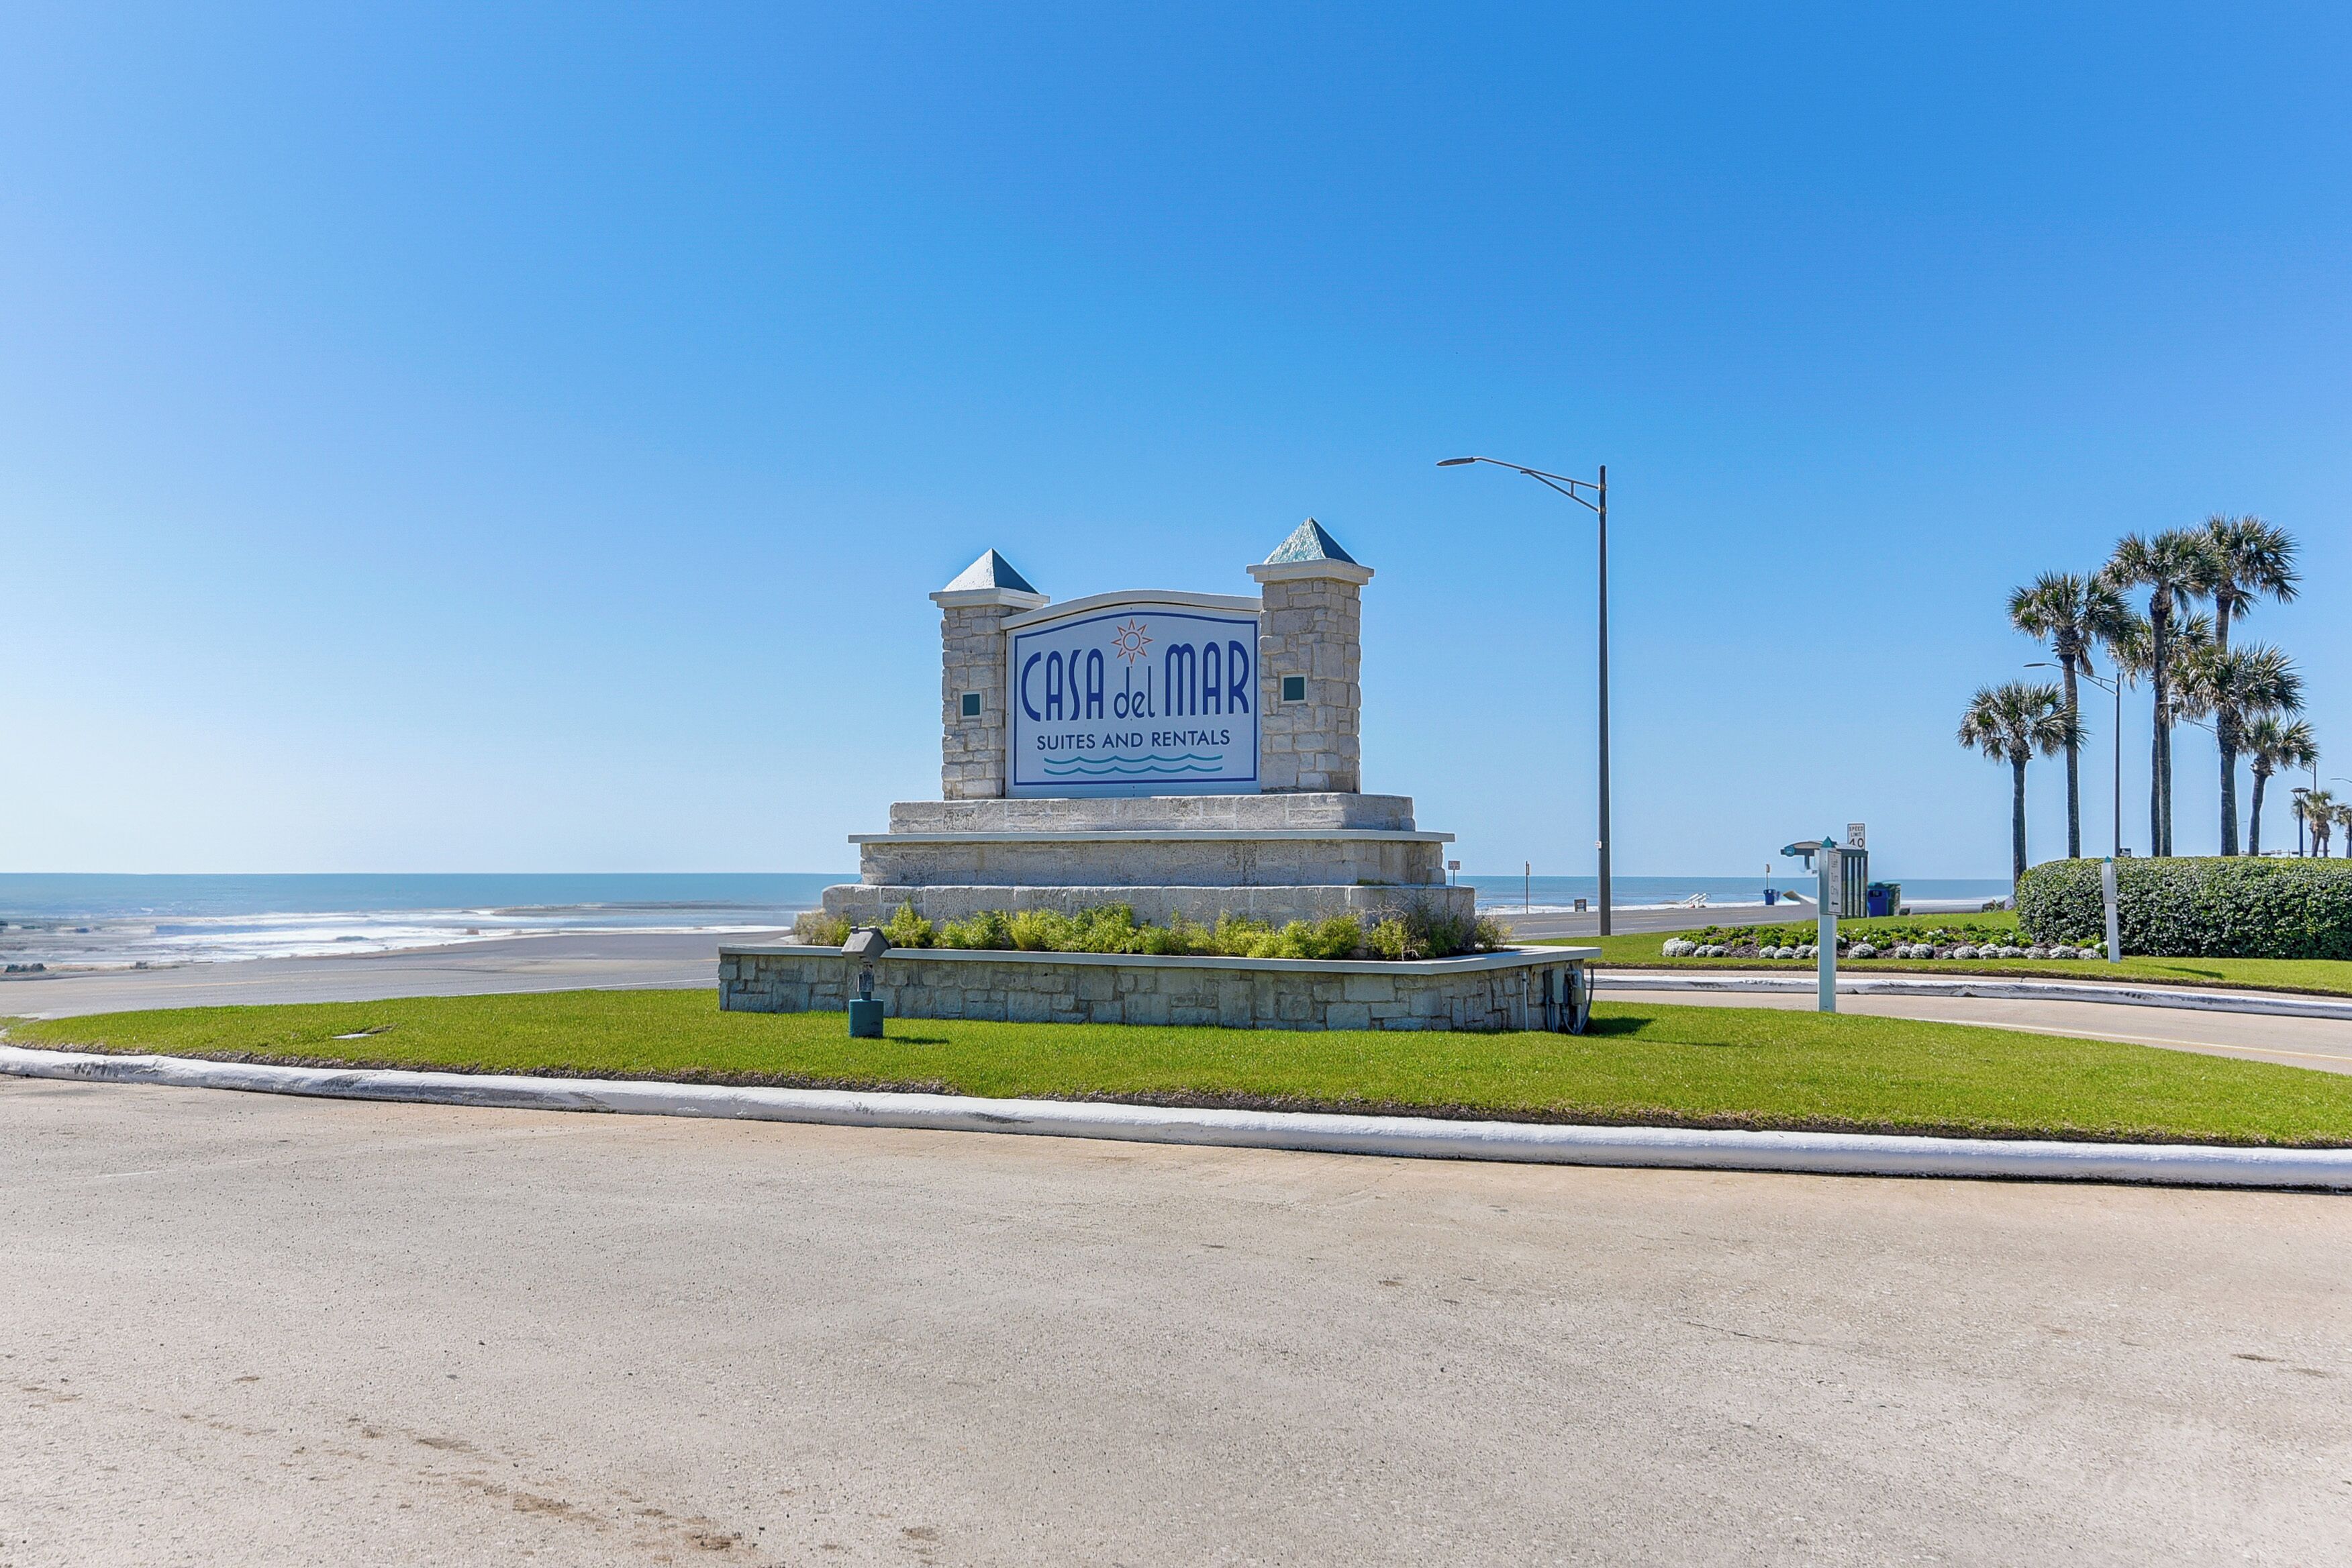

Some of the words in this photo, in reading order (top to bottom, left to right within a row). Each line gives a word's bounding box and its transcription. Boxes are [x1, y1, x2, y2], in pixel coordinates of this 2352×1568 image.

[1021, 648, 1104, 722] CASA
[1114, 666, 1155, 719] del
[1165, 640, 1250, 716] MAR
[1036, 733, 1095, 750] SUITES
[1102, 732, 1143, 748] AND
[1151, 729, 1230, 747] RENTALS
[1849, 838, 1864, 848] 40
